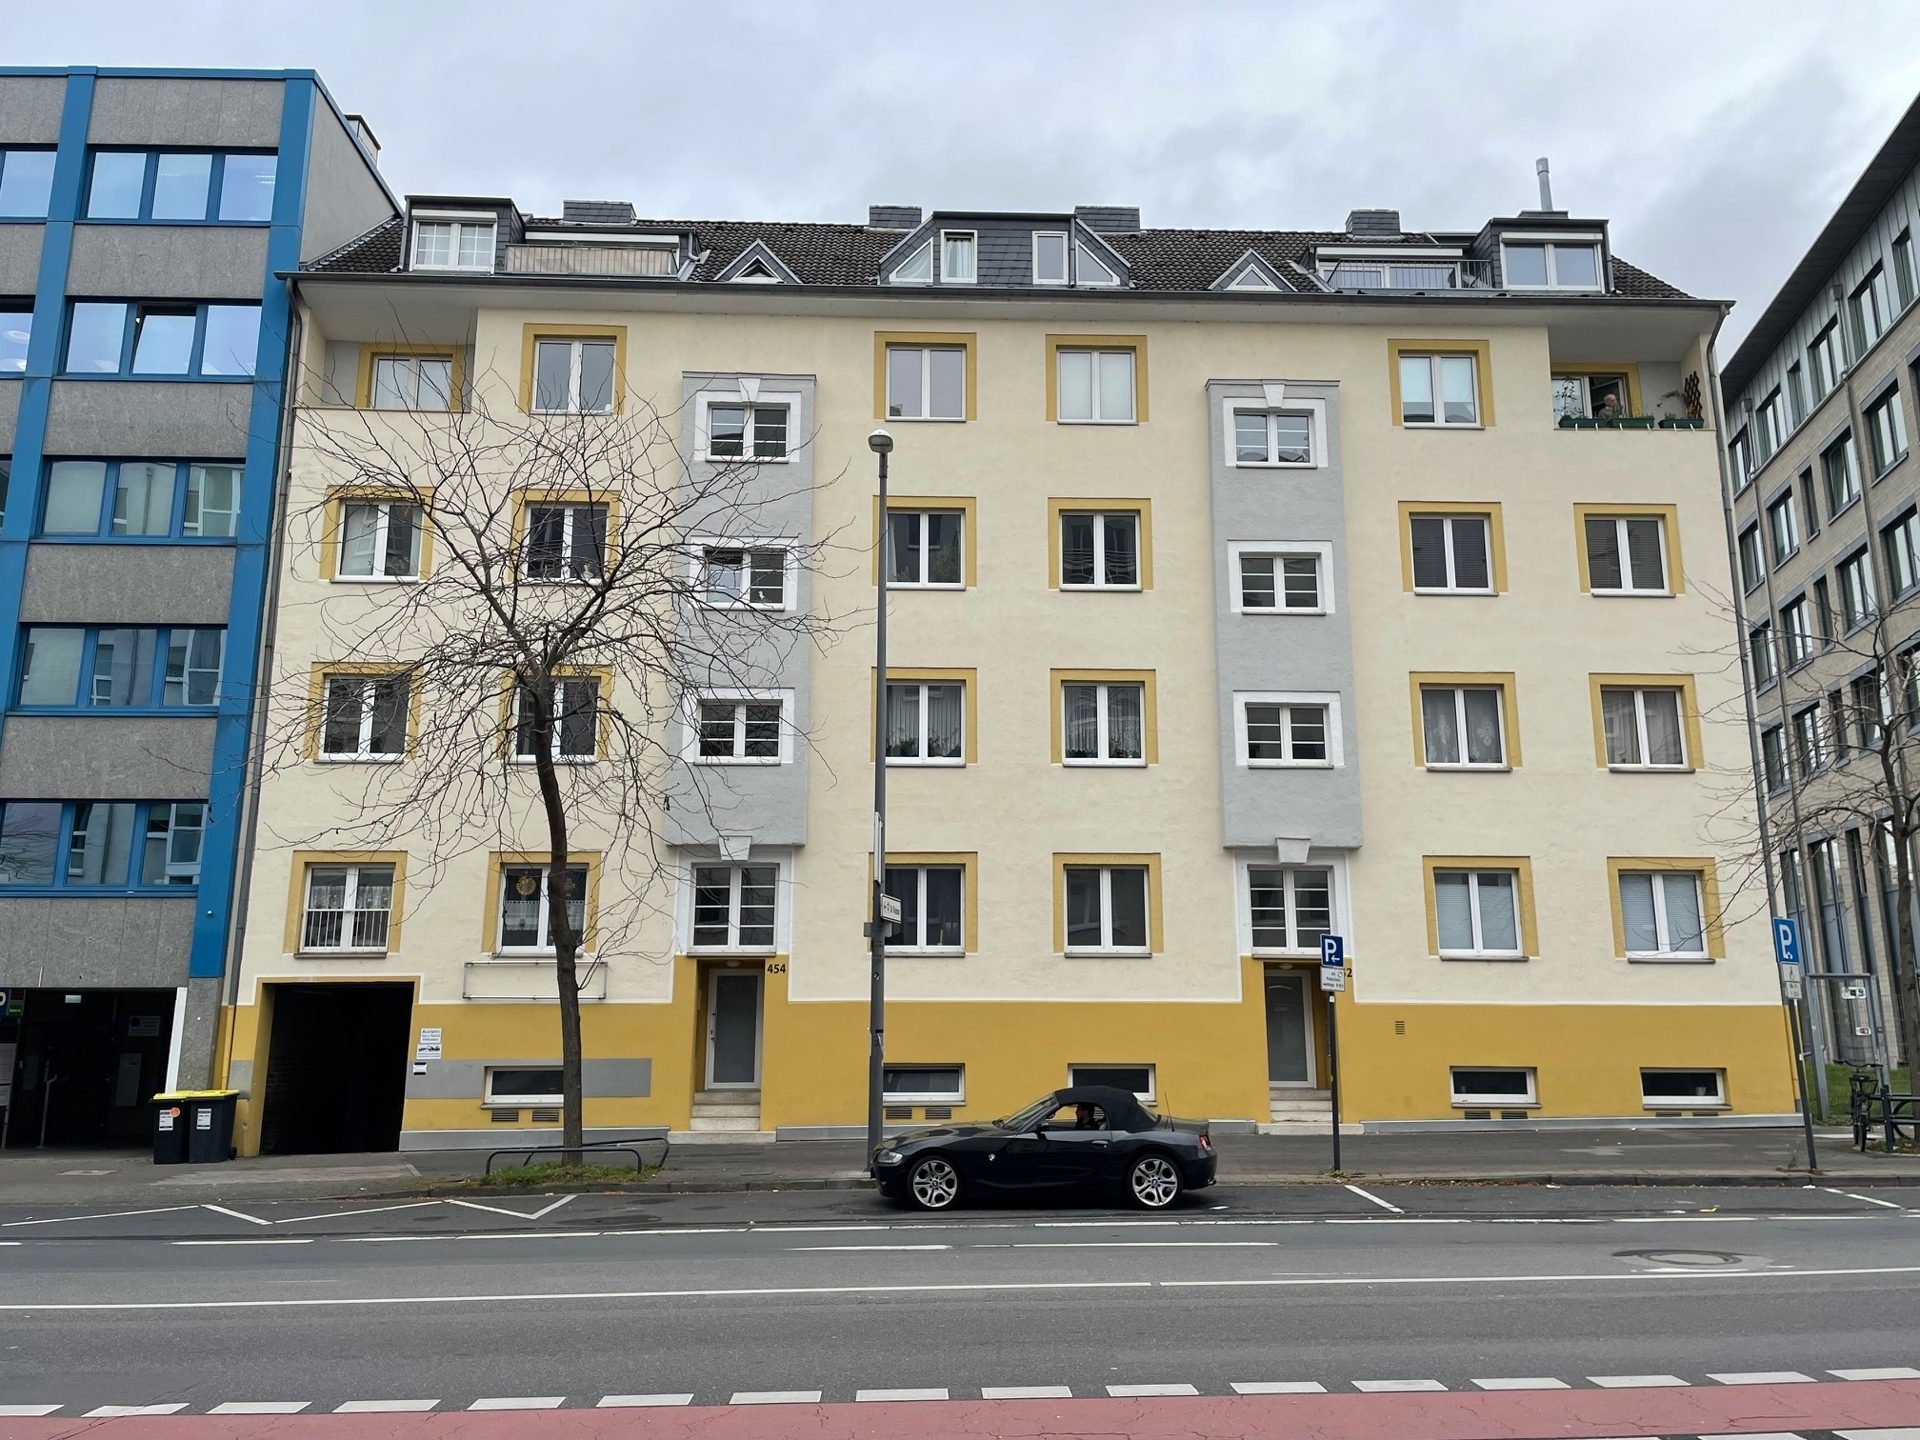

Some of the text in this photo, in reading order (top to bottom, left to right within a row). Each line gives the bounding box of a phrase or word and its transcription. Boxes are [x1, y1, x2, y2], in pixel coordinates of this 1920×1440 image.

[1324, 938, 1337, 962] P
[1778, 924, 1792, 959] P
[767, 963, 786, 974] 454
